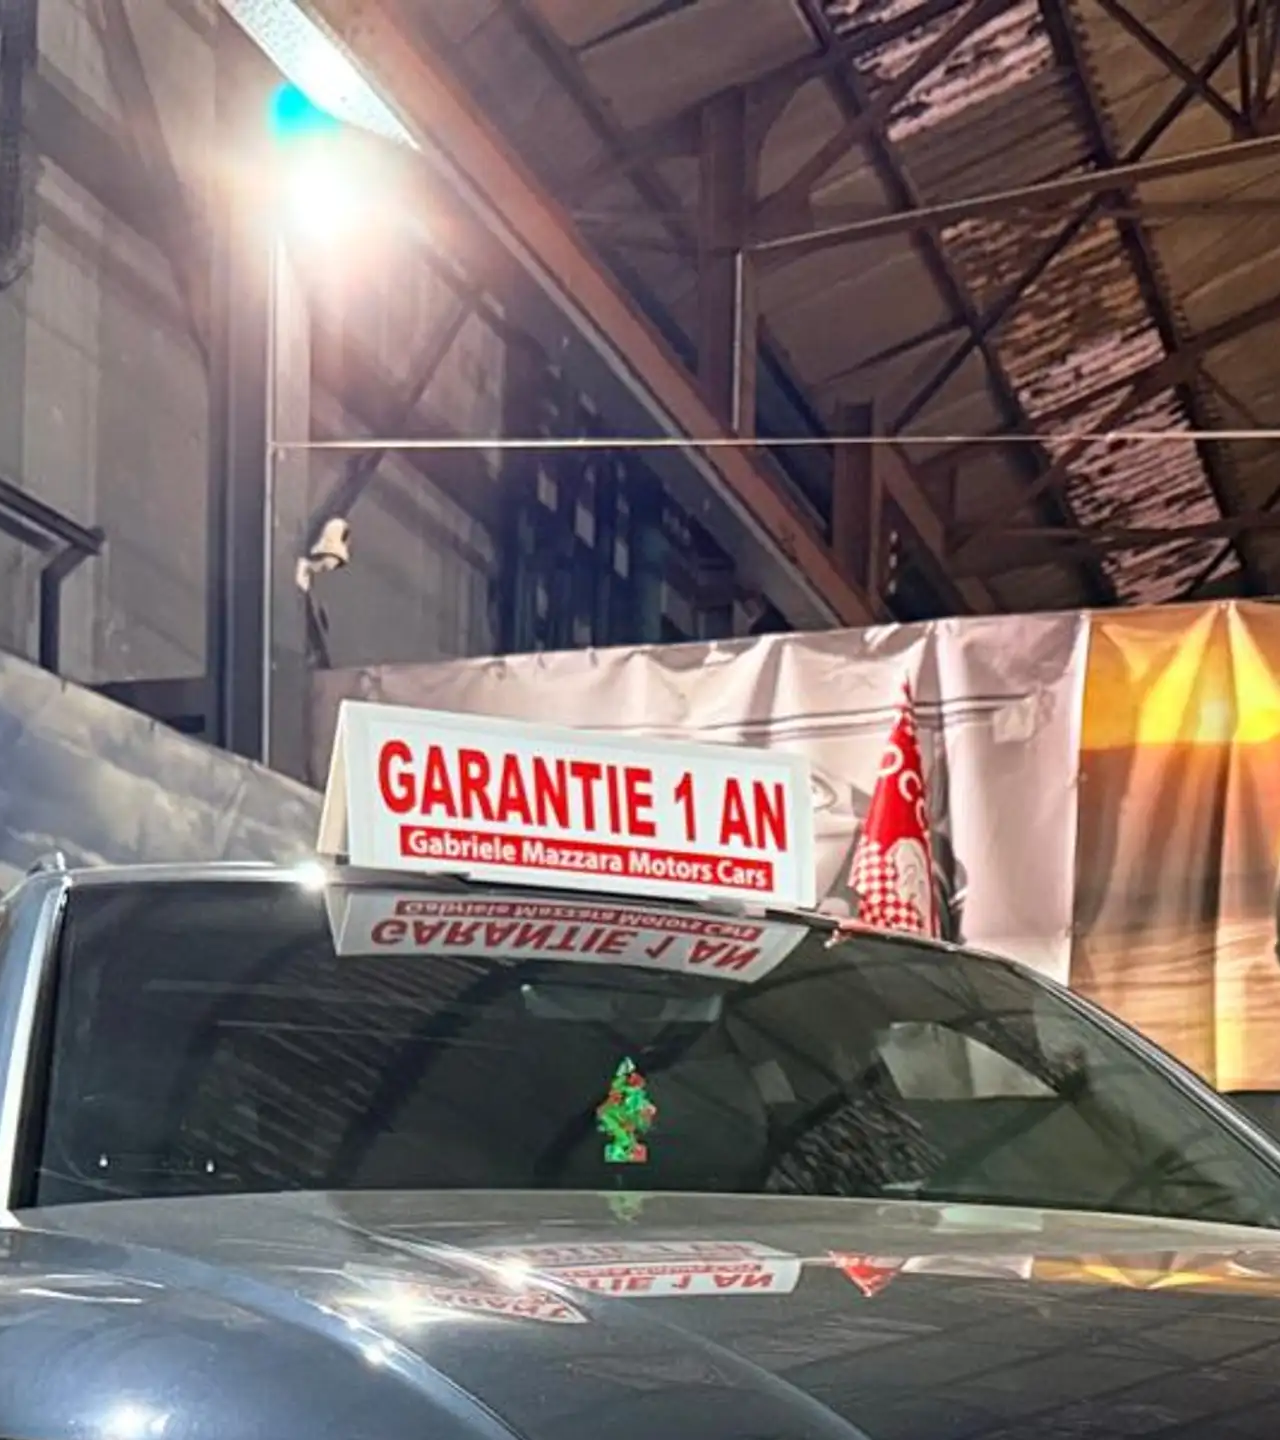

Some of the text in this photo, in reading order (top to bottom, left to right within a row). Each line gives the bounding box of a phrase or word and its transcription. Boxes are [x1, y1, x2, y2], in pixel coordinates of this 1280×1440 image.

[378, 740, 788, 852] GARANTIE 1 AN
[408, 831, 769, 887] Gabriele Mazzara Motors Cars
